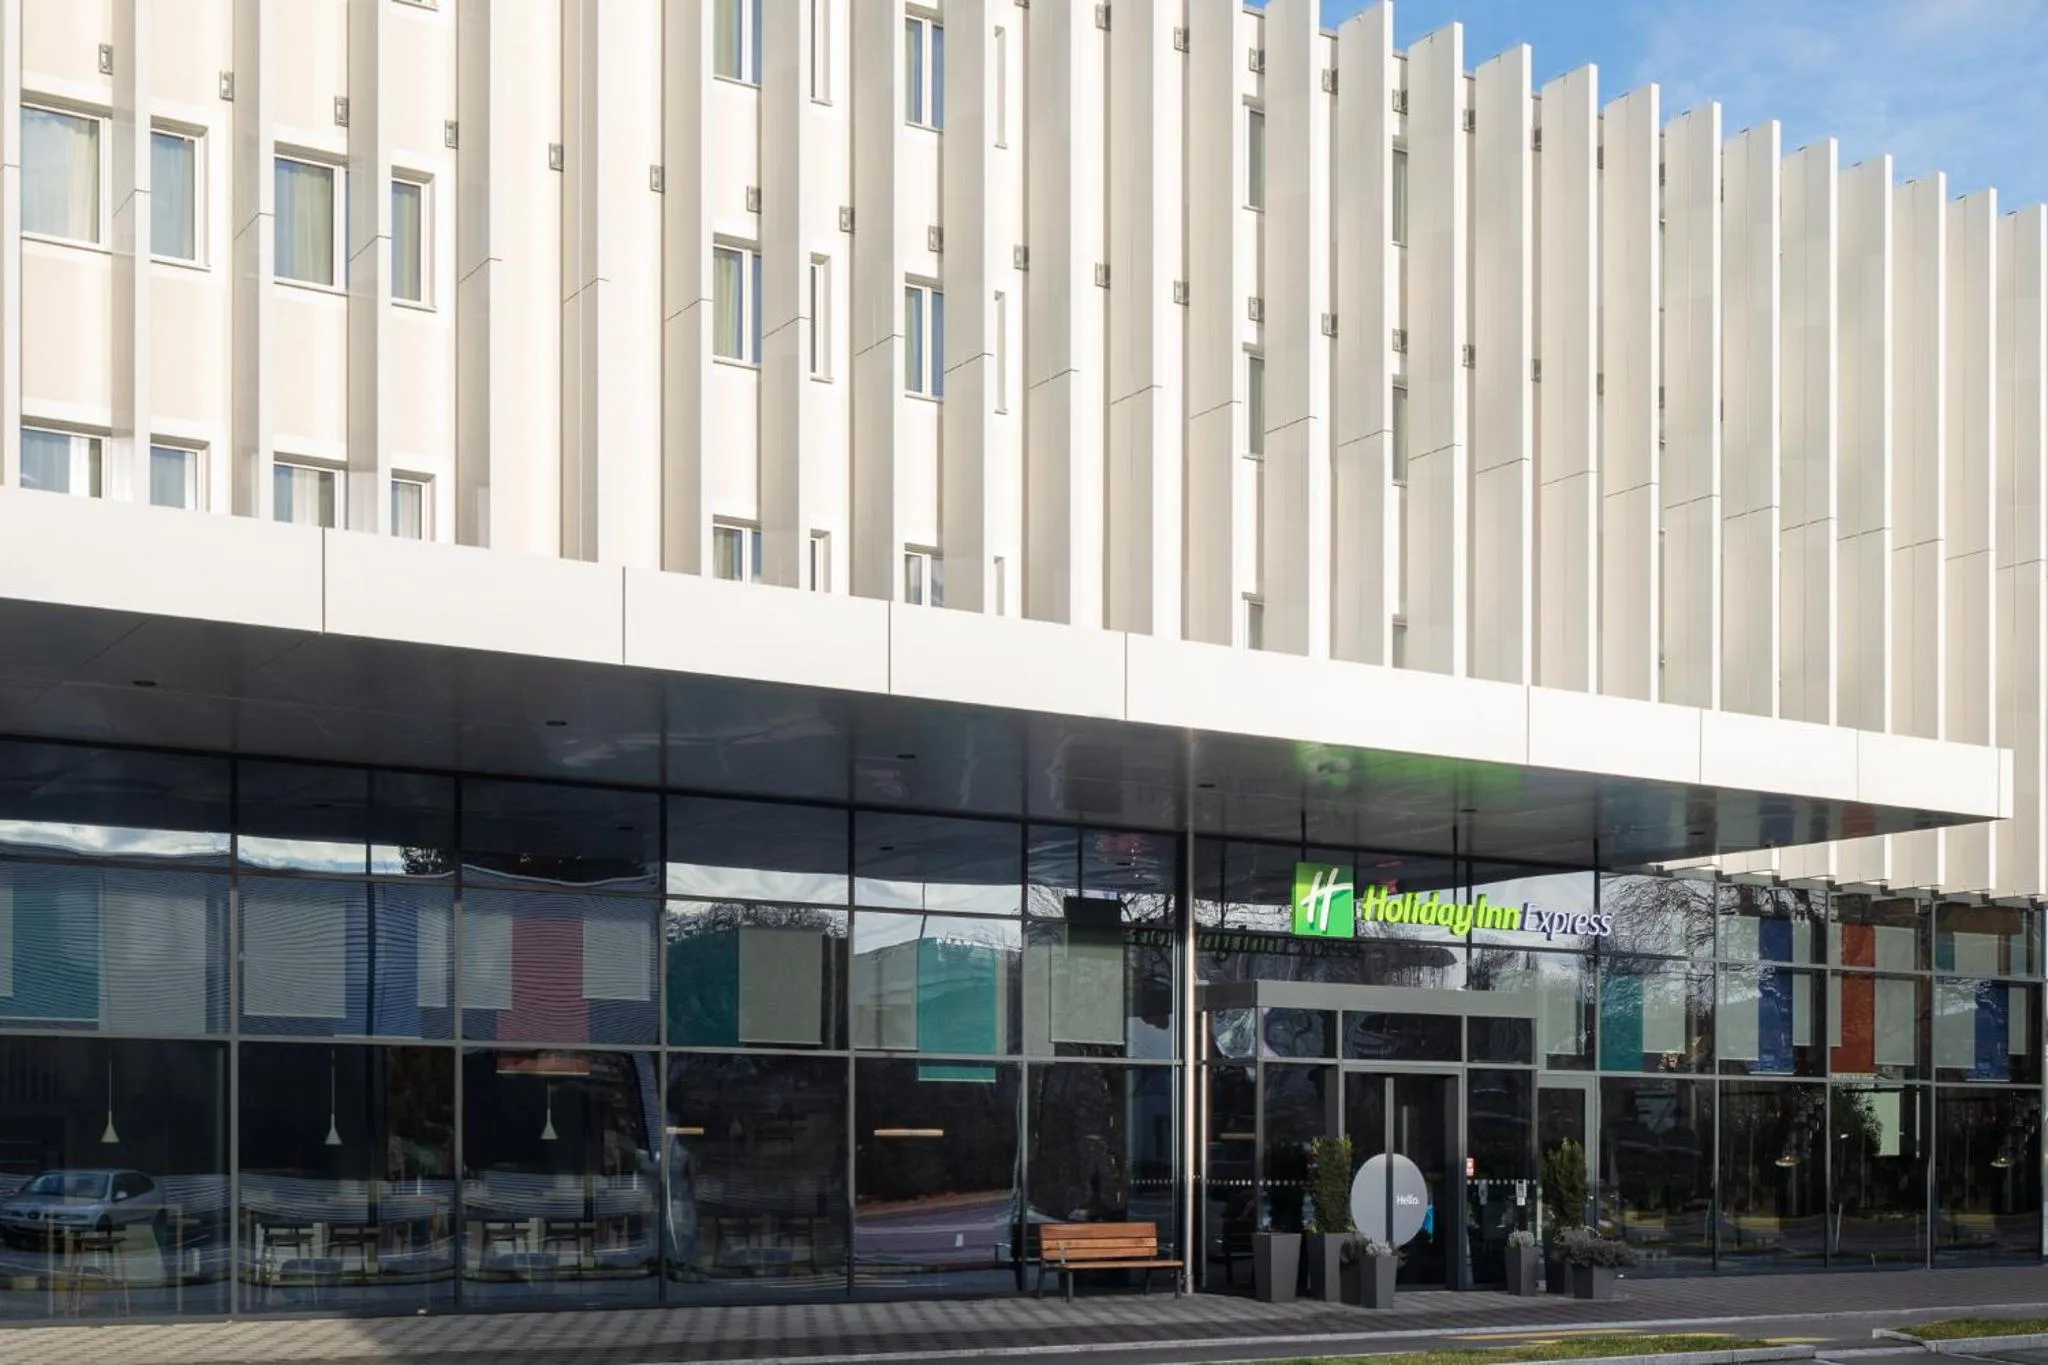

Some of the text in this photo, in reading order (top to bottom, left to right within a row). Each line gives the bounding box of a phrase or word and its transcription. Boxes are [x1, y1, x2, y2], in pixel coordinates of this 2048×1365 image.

[1362, 884, 1613, 941] Holiday Inn Express
